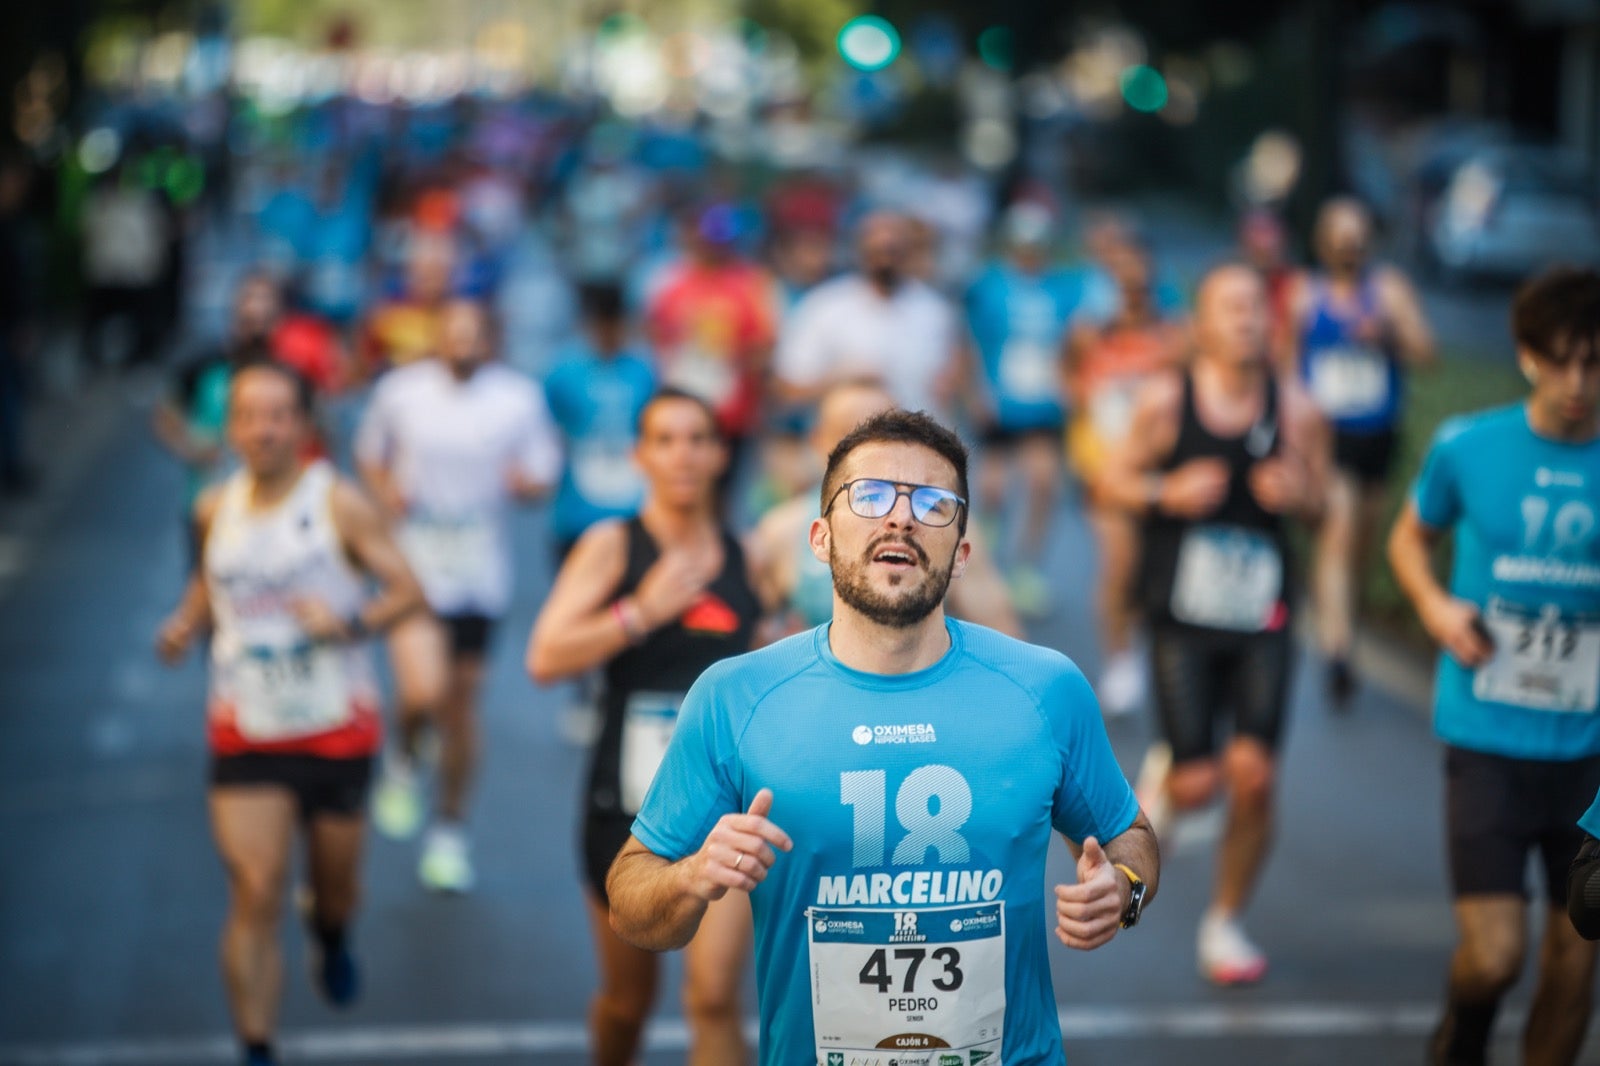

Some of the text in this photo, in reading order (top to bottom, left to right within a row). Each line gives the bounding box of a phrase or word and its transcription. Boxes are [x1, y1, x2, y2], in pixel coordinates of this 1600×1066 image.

[873, 723, 935, 736] OXIMESA
[874, 735, 907, 744] NIPPON
[840, 764, 972, 868] 18
[816, 869, 1003, 905] MARCELINO
[828, 921, 864, 929] OXIMESA
[894, 912, 917, 930] 18
[963, 915, 997, 926] OXIMESA
[859, 947, 963, 993] 473
[889, 997, 938, 1012] PEDRO
[896, 1036, 929, 1046] CAJÓN 4
